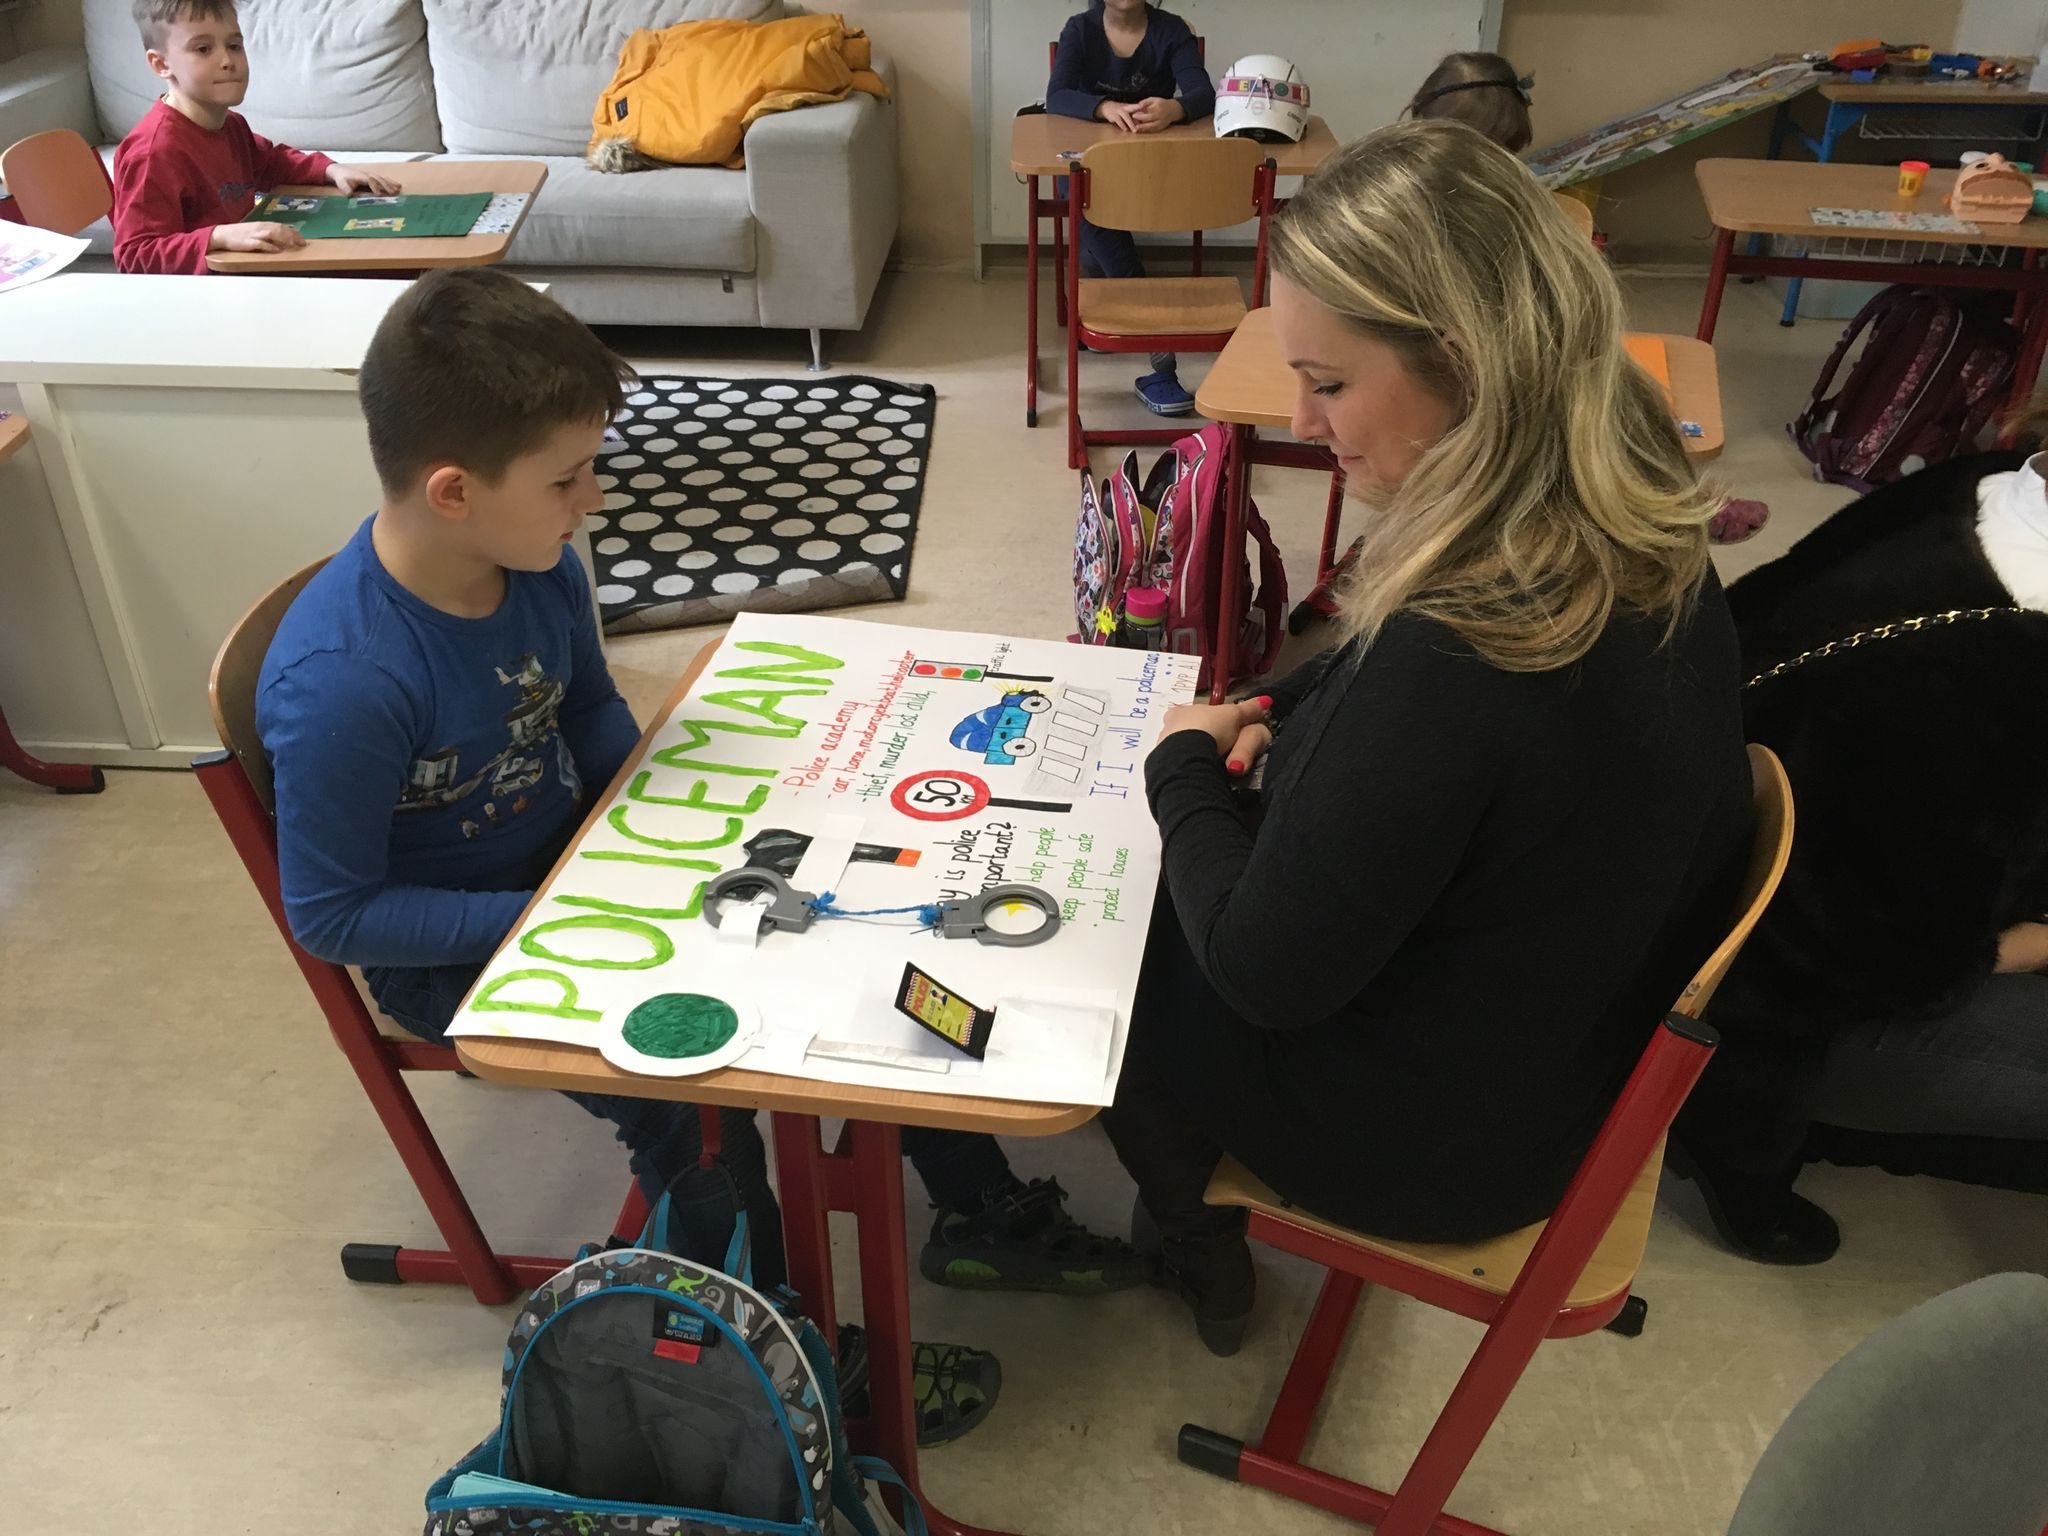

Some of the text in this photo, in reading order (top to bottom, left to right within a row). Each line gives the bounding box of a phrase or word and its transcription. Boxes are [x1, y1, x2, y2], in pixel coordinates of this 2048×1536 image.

[1109, 707, 1148, 720] be
[1135, 696, 1149, 705] a
[885, 713, 919, 730] lost
[782, 701, 868, 788] Police academy
[1106, 726, 1143, 750] will
[1096, 760, 1134, 774] I
[913, 779, 962, 807] 50
[1088, 779, 1129, 800] If
[470, 642, 846, 1022] POLICEMAN
[1067, 832, 1094, 853] safe
[932, 829, 983, 864] police
[978, 822, 1019, 894] mportant?
[1014, 827, 1063, 883] help people
[934, 869, 966, 881] is
[1061, 859, 1095, 891] people
[1092, 847, 1129, 922] protect houses
